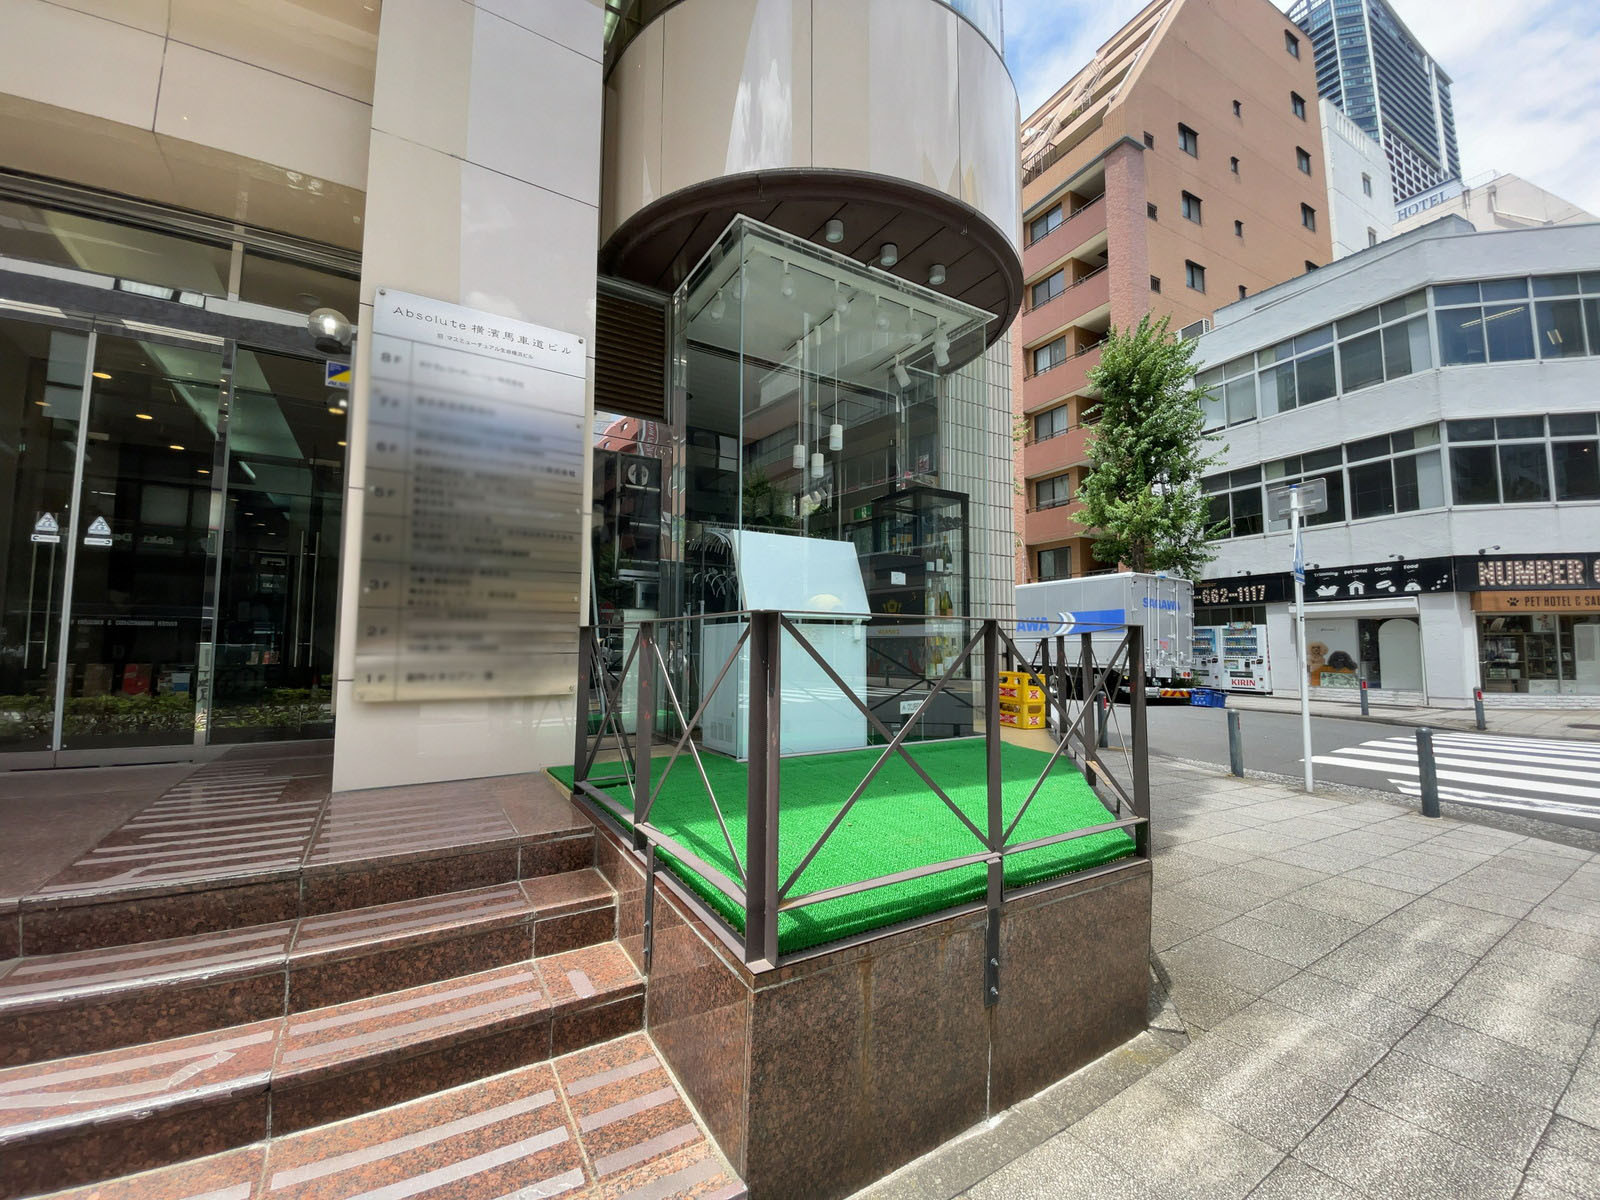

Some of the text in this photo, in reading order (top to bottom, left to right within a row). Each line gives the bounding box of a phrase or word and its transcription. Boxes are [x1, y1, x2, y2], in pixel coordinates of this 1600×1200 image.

[1397, 191, 1450, 221] HOTEL
[393, 306, 571, 354] Absolute 横濱馬車道ビル
[1478, 559, 1585, 586] NUMBER
[1524, 596, 1539, 607] PET
[1544, 596, 1572, 607] HOTEL
[1231, 679, 1256, 687] KIRIN
